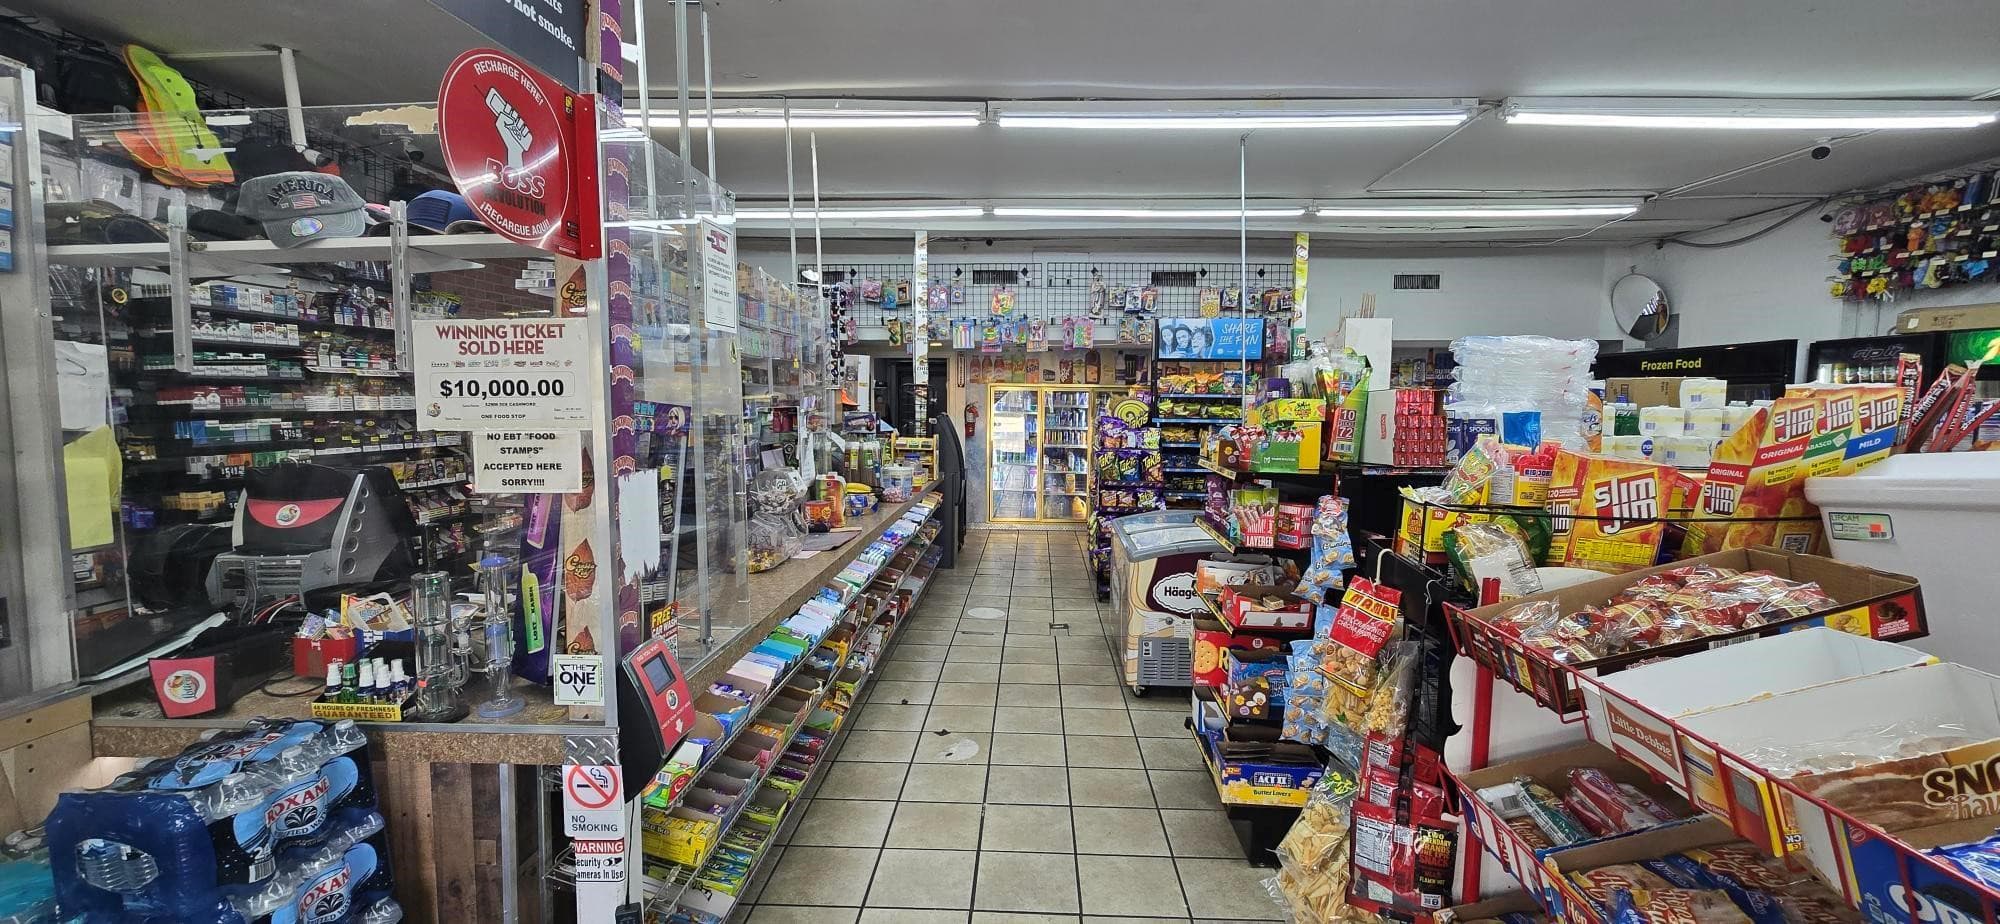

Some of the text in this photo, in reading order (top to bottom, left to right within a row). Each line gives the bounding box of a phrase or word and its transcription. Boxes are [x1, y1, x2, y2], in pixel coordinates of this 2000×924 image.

[513, 0, 538, 22] not
[538, 14, 576, 51] smoke.
[473, 60, 544, 107] RECHARGE HERE!
[486, 157, 546, 199] BOSS
[267, 179, 334, 206] AMERICA
[435, 323, 566, 340] WINNING TICKET
[1221, 322, 1261, 334] SHARE
[1219, 334, 1259, 345] THE FUN
[458, 340, 545, 356] SOLD HERE
[1641, 358, 1702, 371] Frozen Food
[440, 379, 565, 400] $10,000.00
[1342, 410, 1356, 421] 10
[1774, 405, 1815, 427] slim
[1859, 397, 1898, 422] slim
[1865, 412, 1898, 434] jim
[486, 432, 556, 441] NO EBT "FOOD
[1339, 427, 1353, 438] 72
[1783, 419, 1814, 442] jim
[1806, 440, 1833, 451] ABASCO
[1858, 437, 1881, 450] MILD
[500, 447, 544, 455] STAMPS"
[1761, 444, 1804, 460] ORIGINAL
[483, 462, 563, 471] ACCEPTED HERE
[1710, 468, 1744, 478] ORIGINAL
[501, 478, 545, 486] SORRY!!!!
[1547, 489, 1559, 498] 120
[1594, 477, 1657, 508] slim
[1703, 482, 1735, 500] slim
[1704, 499, 1734, 514] jim
[1603, 498, 1658, 534] jim
[1246, 535, 1274, 548] LAYERED
[1164, 586, 1201, 599] Häage
[652, 606, 673, 628] FREE
[663, 616, 678, 633] WASH
[560, 672, 596, 685] ONE
[314, 710, 396, 719] GUARANTEED!
[1610, 712, 1673, 757] Little Debbie
[1258, 775, 1287, 784] ACT II
[1925, 757, 2000, 804] UNS
[1945, 796, 2000, 821] ney
[571, 814, 586, 823] NO
[571, 823, 618, 832] SMOKING
[574, 841, 624, 853] WARNING
[575, 856, 601, 869] ecurity
[575, 868, 624, 879] ameras In Use
[299, 866, 350, 914] OXAN
